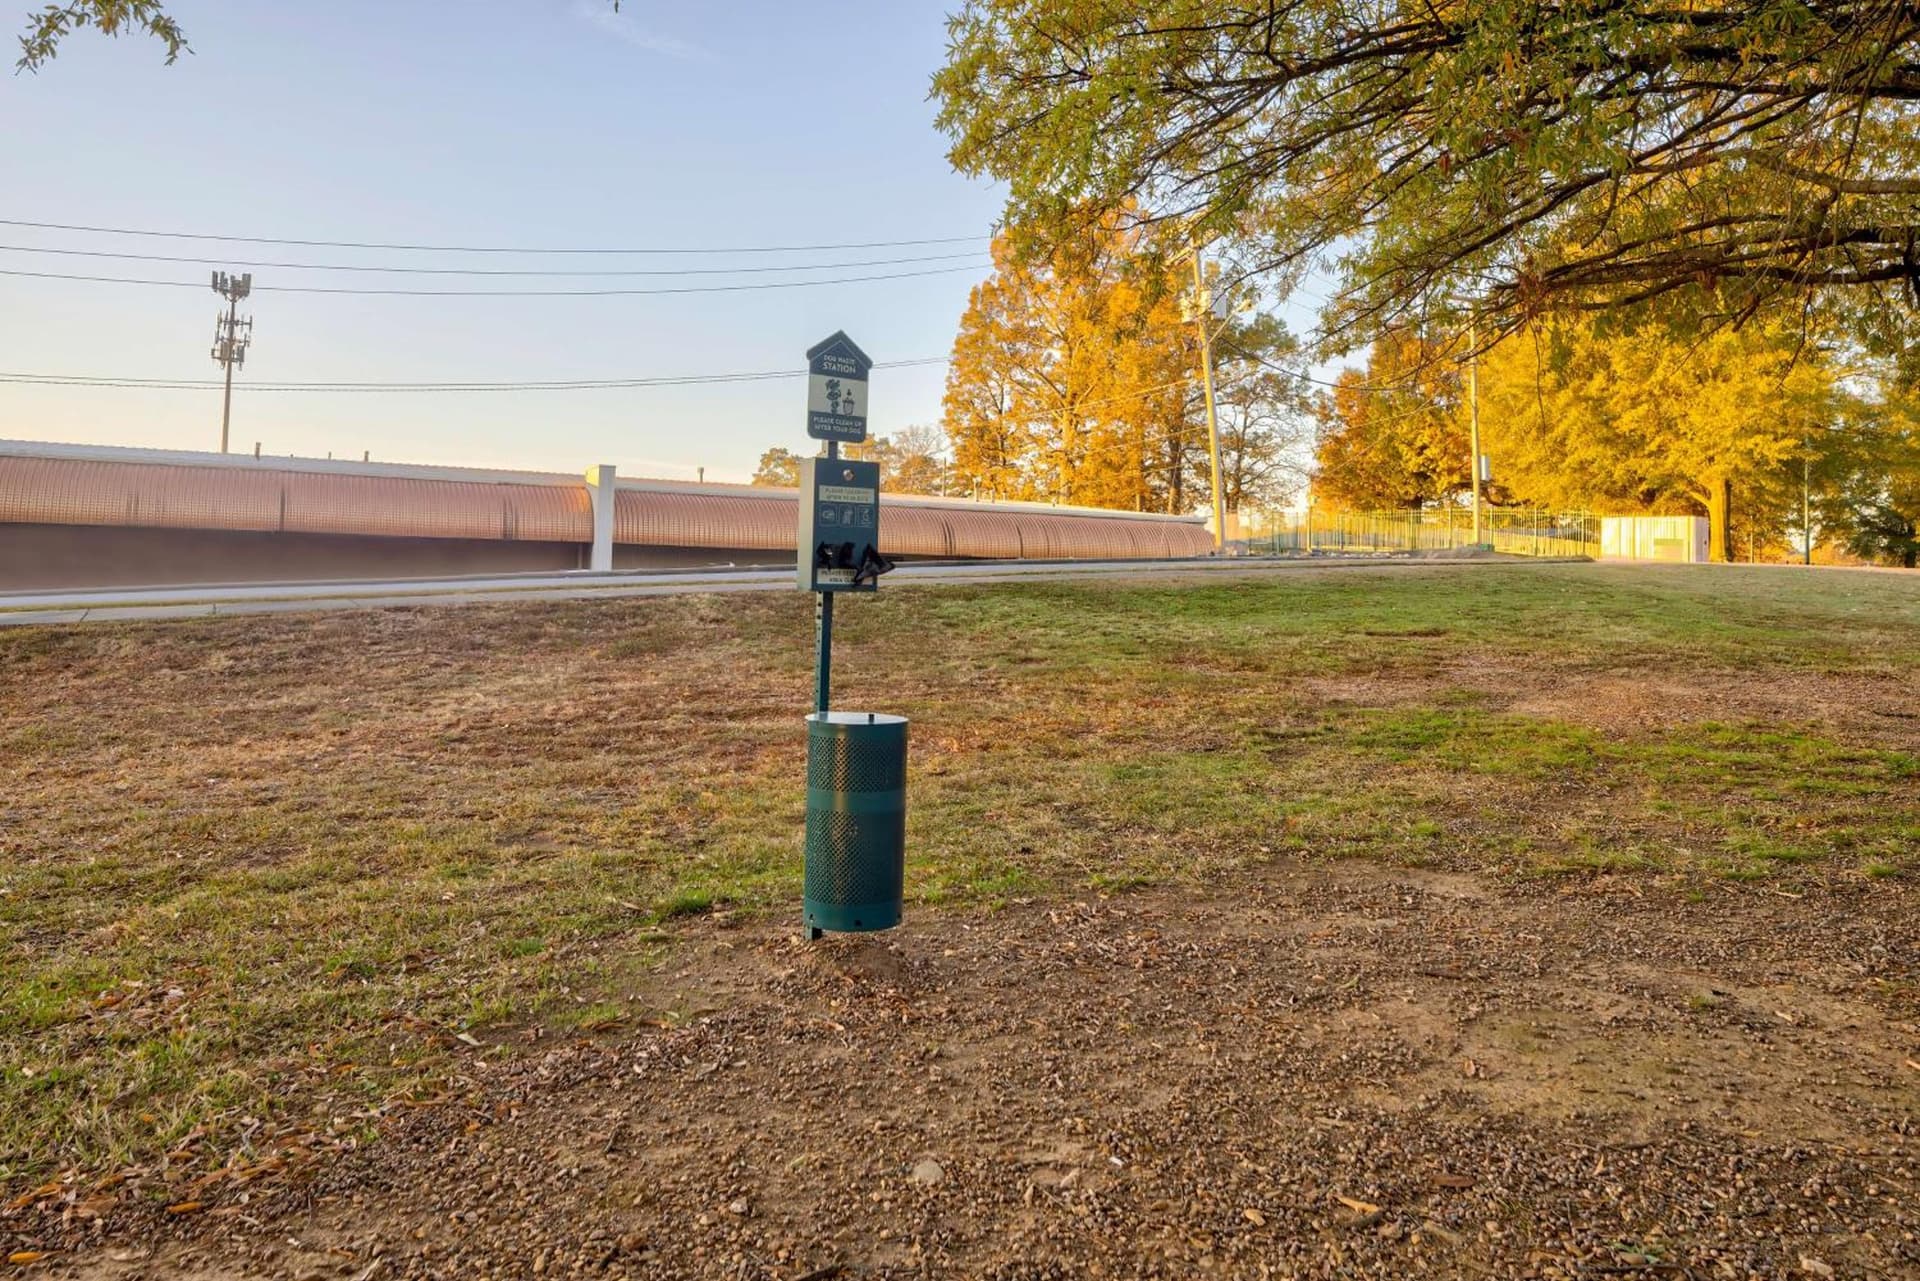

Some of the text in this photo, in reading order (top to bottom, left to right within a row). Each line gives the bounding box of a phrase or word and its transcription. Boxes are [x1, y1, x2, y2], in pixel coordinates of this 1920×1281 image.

[823, 362, 856, 374] STATION
[813, 416, 834, 424] PLEASE
[814, 423, 831, 431] AFTER
[833, 425, 848, 433] YOUR
